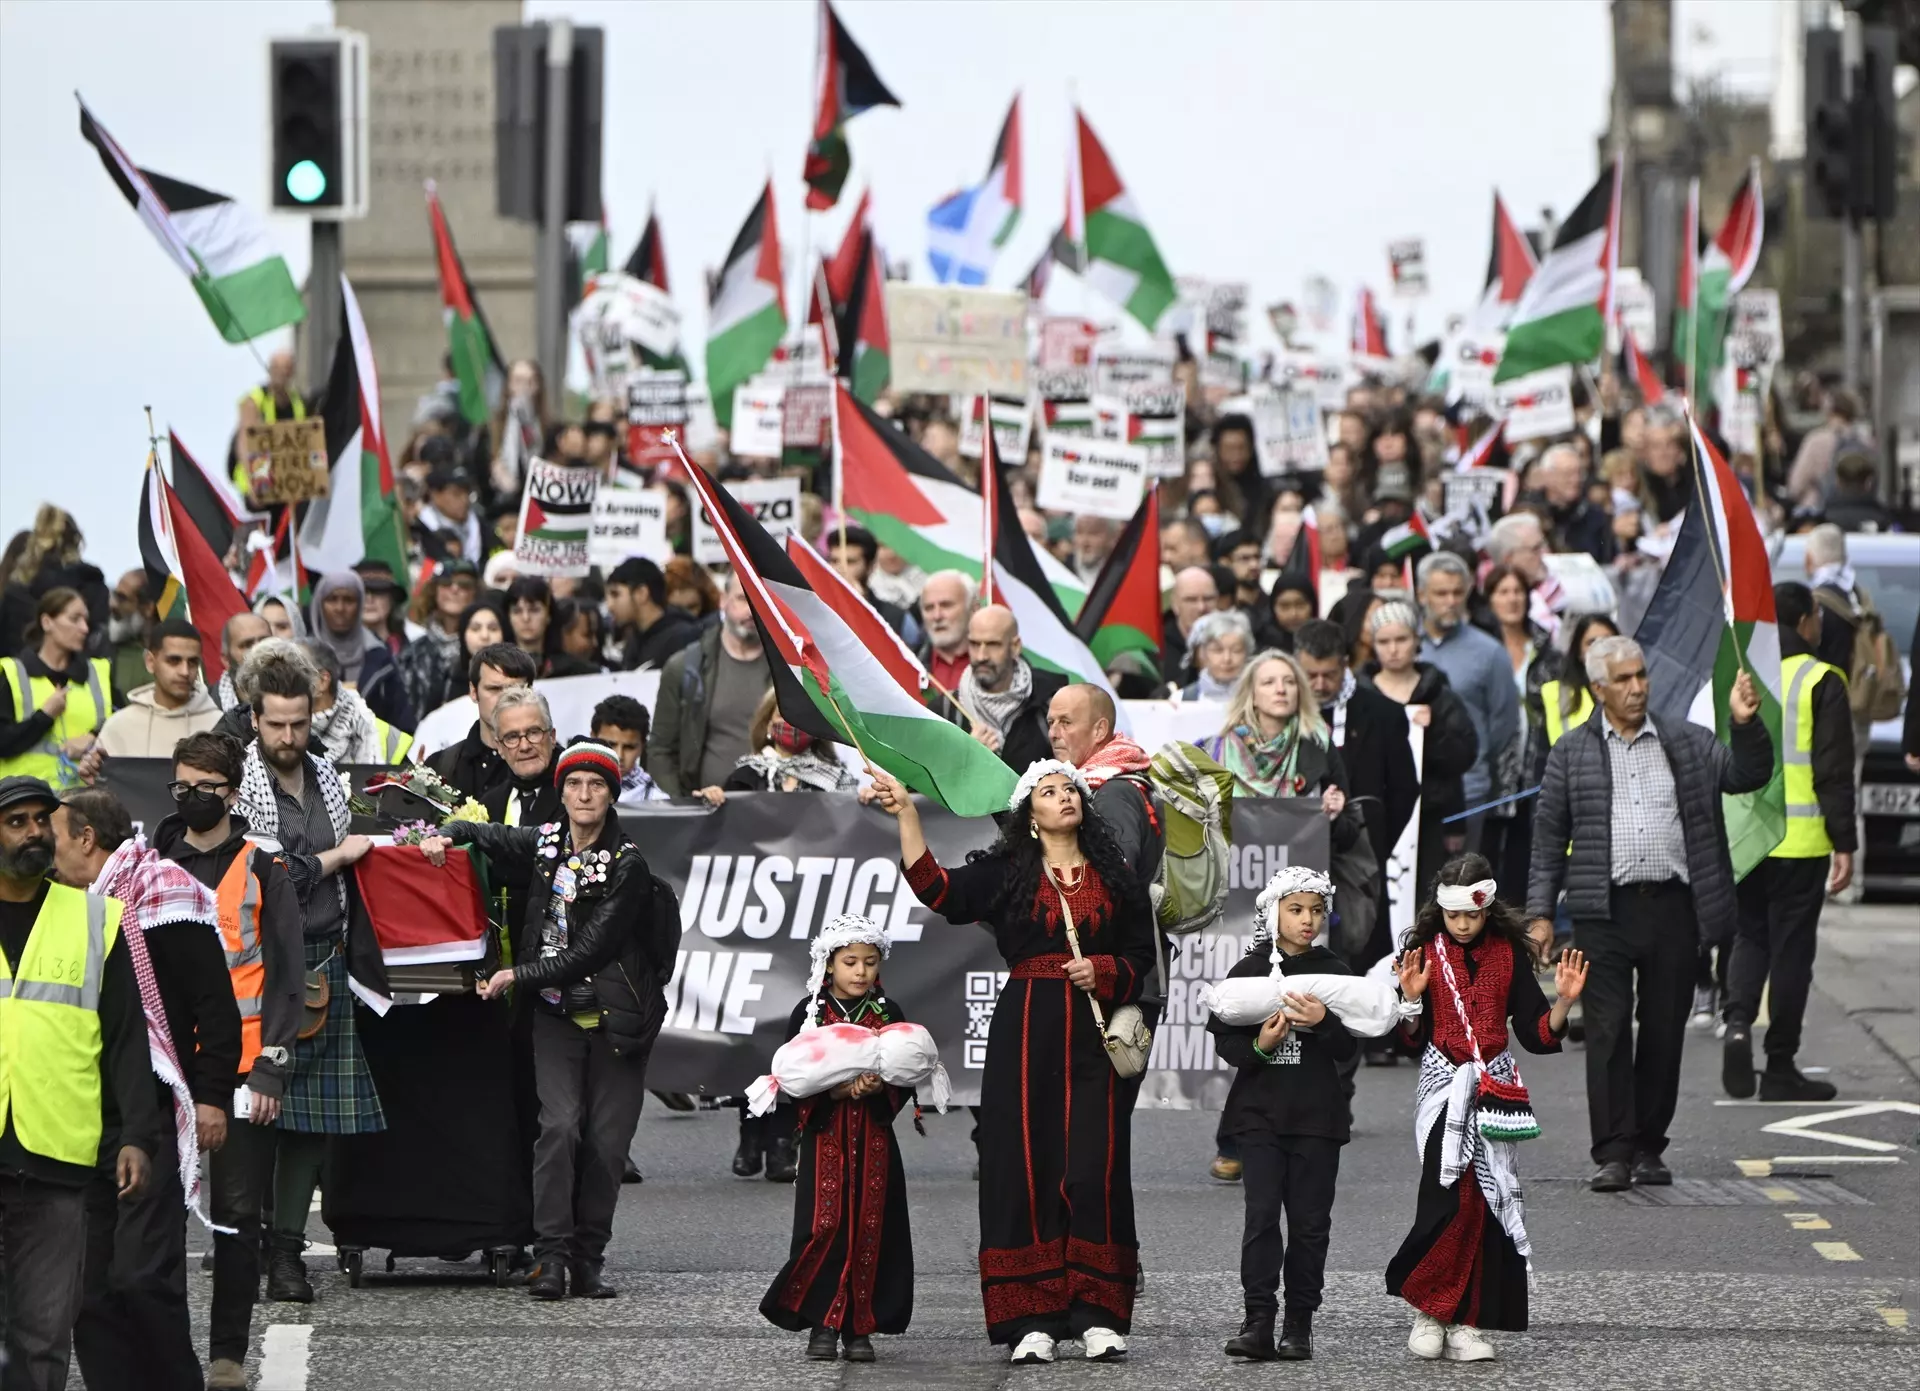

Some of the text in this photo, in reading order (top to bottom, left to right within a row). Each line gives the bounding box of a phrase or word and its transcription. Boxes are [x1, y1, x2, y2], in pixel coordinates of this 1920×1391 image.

[529, 474, 598, 505] NOW!
[681, 855, 938, 942] JUSTICE
[38, 956, 80, 982] 136
